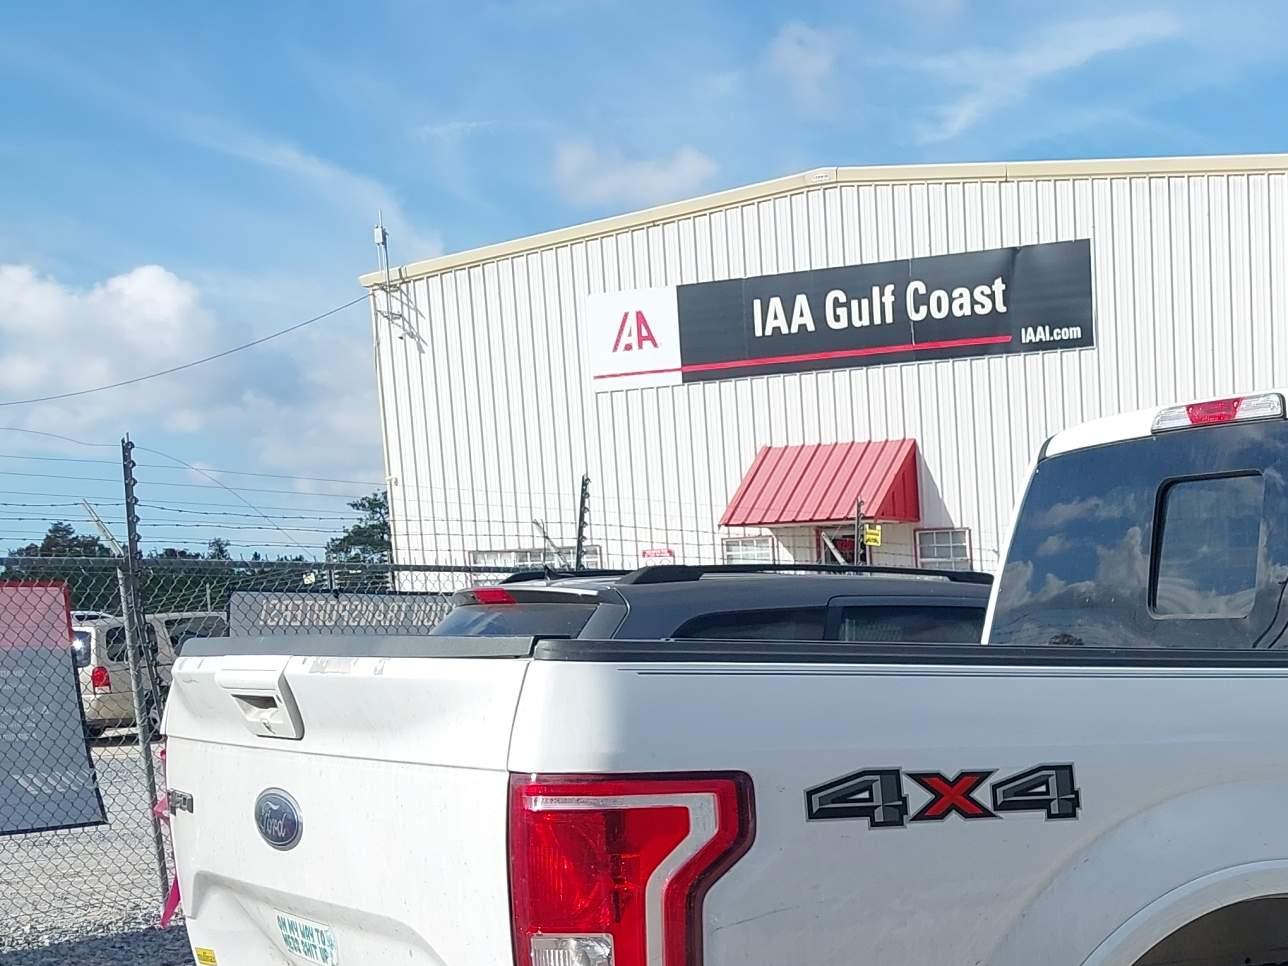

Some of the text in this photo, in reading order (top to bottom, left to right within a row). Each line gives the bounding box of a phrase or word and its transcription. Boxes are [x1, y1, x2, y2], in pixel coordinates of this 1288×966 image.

[753, 276, 1007, 337] IAA Gulf Coast
[1021, 325, 1082, 344] IAAI.com
